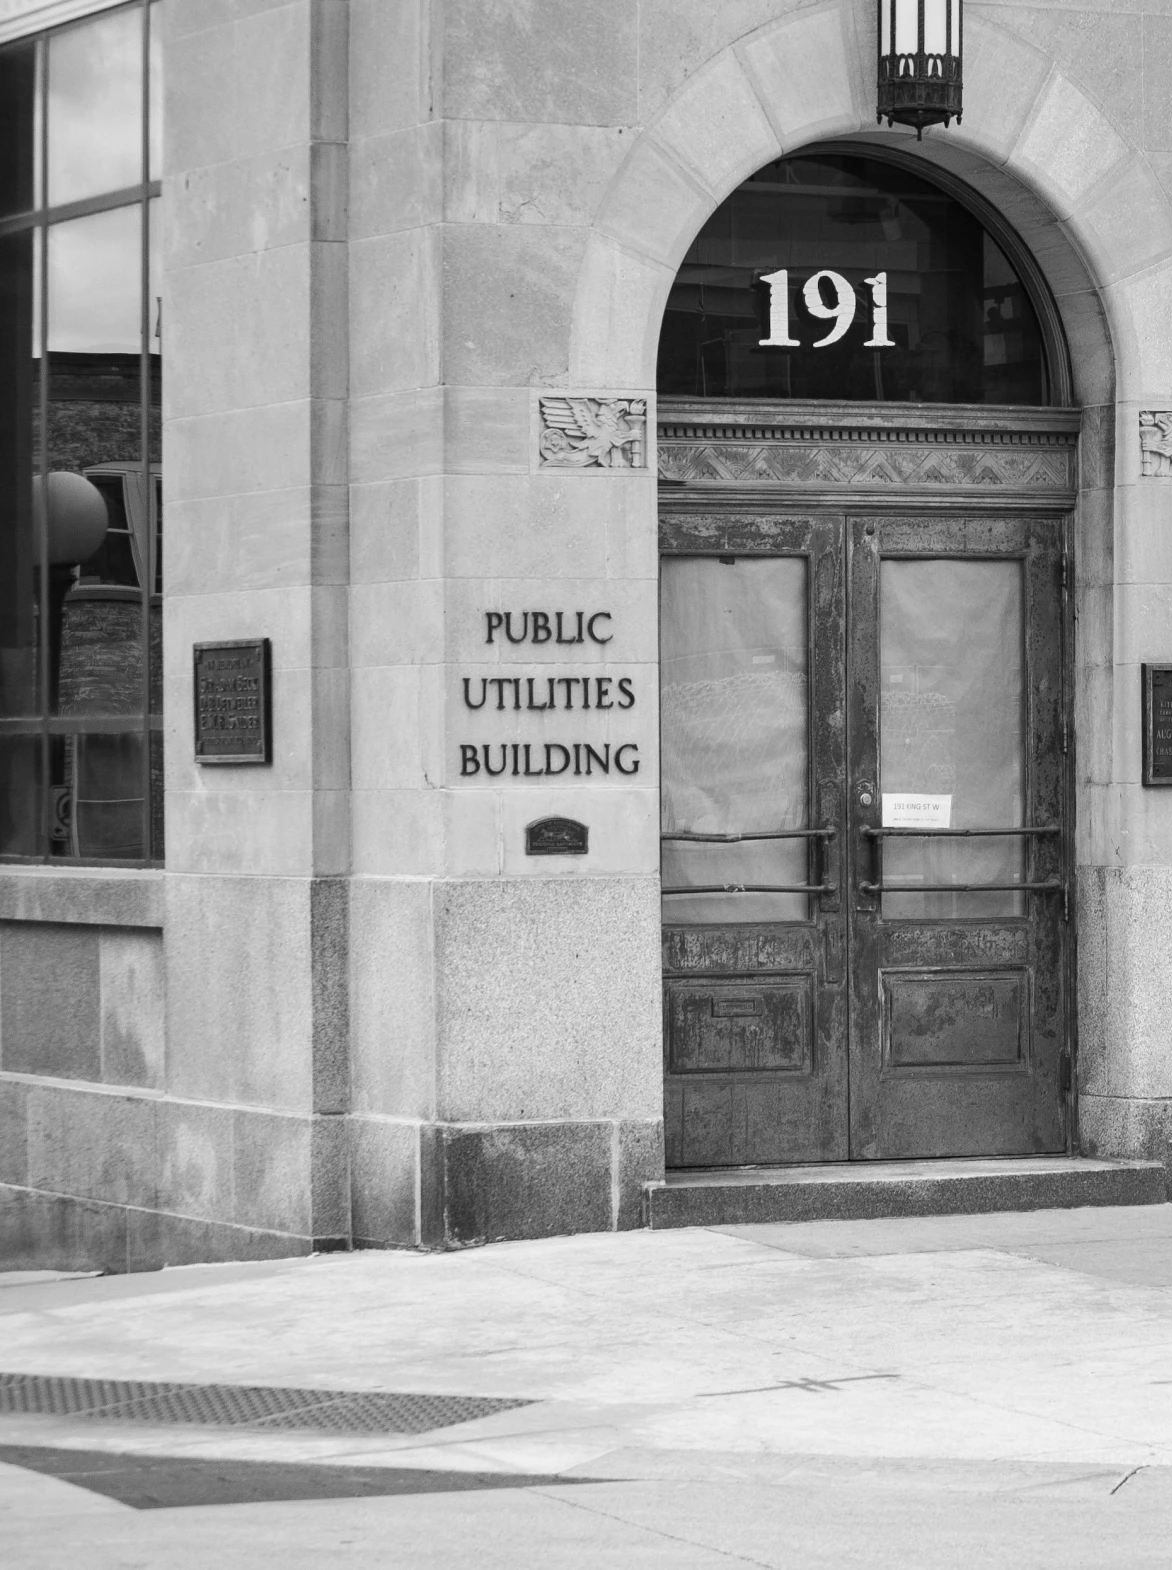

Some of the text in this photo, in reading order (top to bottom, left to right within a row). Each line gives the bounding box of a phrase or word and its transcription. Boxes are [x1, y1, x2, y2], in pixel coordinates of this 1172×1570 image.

[758, 269, 896, 347] 191
[485, 611, 613, 644] PUBLIC
[462, 677, 636, 710] UTILITIES
[459, 743, 640, 776] BUILDING
[922, 803, 931, 811] ST
